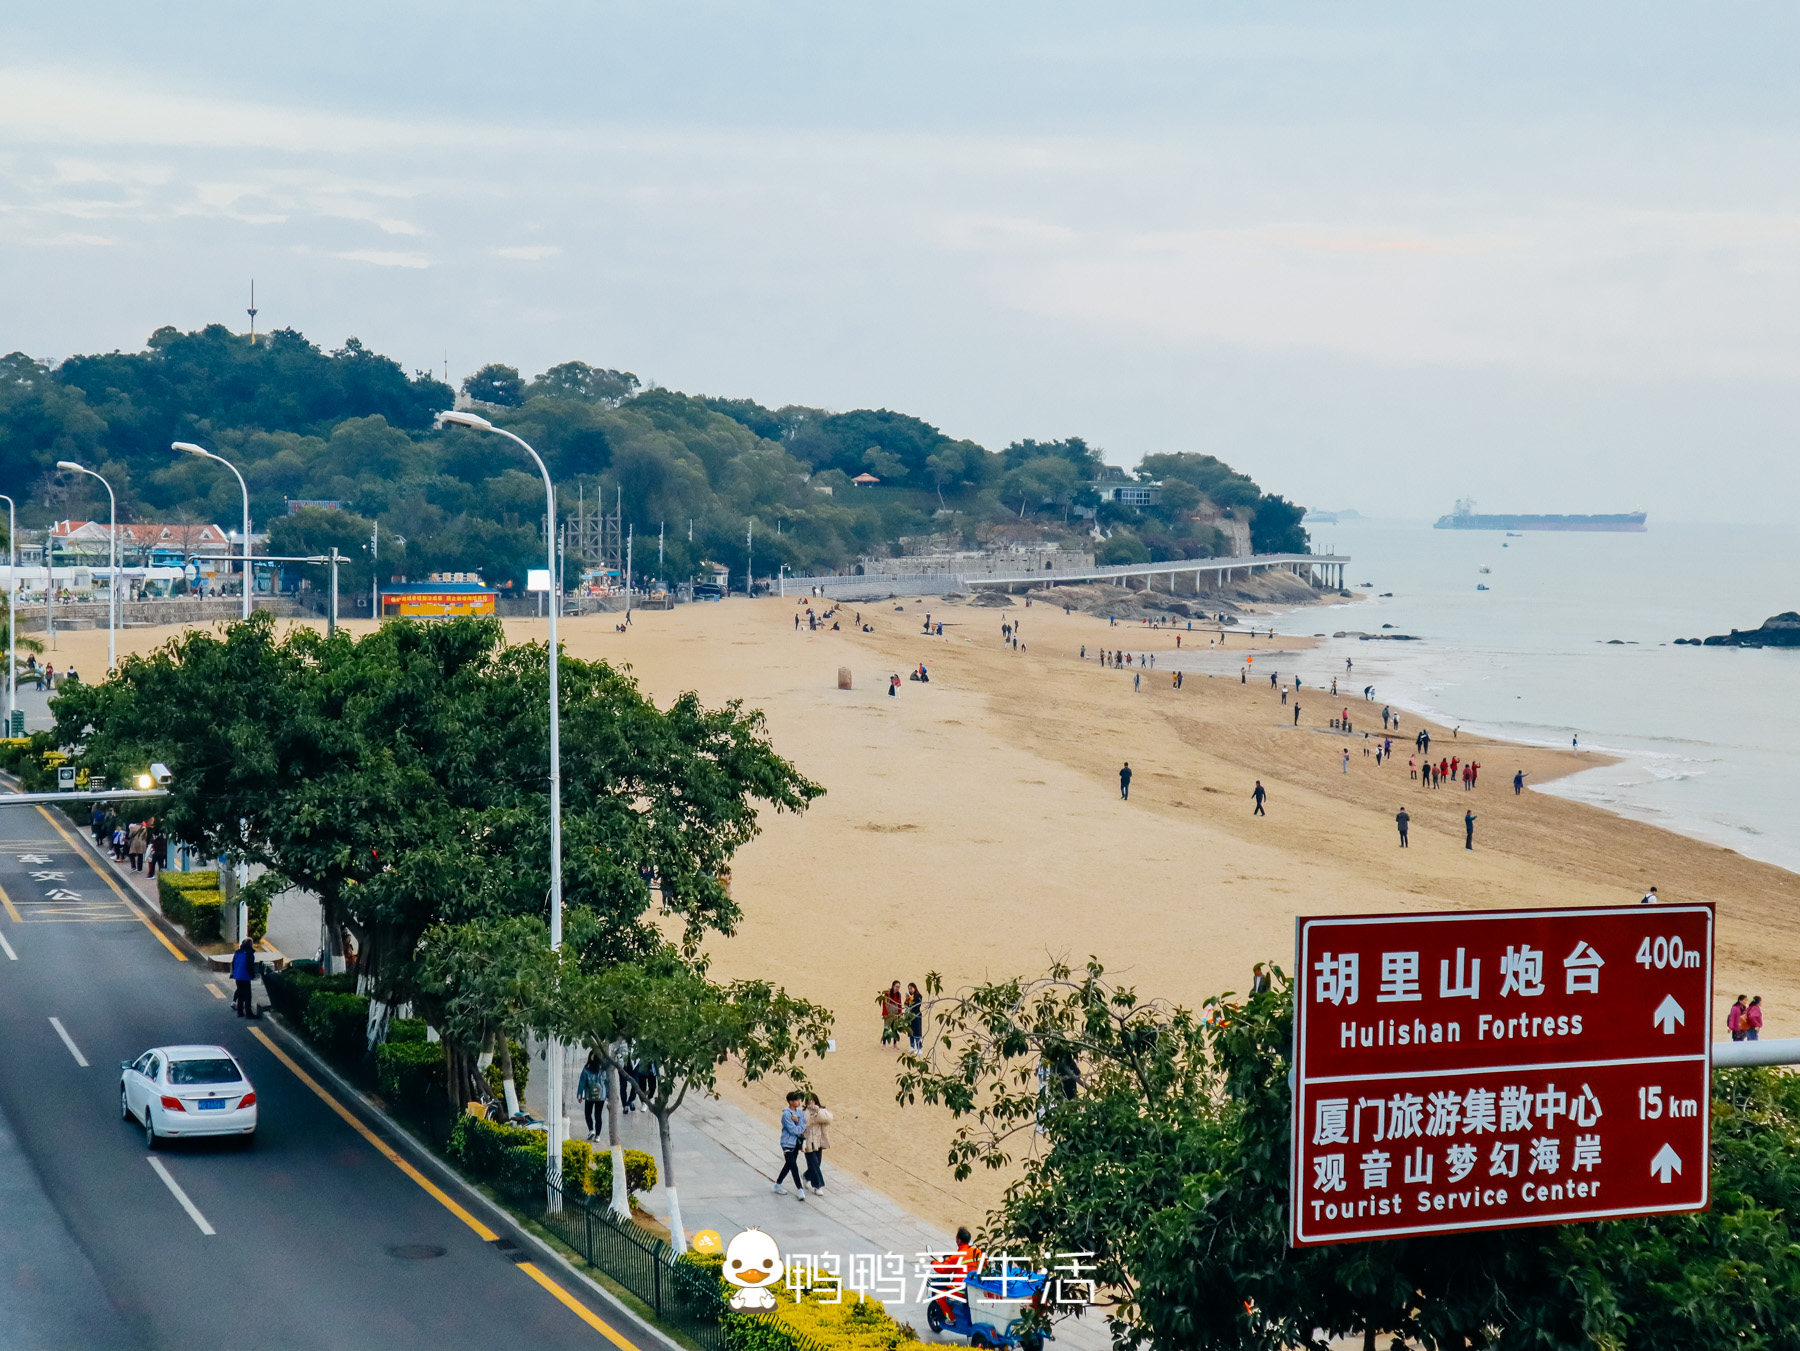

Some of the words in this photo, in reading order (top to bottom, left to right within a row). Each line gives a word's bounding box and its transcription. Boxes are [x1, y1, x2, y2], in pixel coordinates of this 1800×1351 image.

[1314, 941, 1605, 1006] 胡里山炮台
[1636, 936, 1700, 969] 400m
[1341, 1019, 1461, 1048] Hulishan
[1479, 1012, 1583, 1040] Fortress
[1312, 1083, 1603, 1146] 厦门旅游集散中心
[1639, 1086, 1663, 1121] 15
[1670, 1096, 1698, 1118] km
[1313, 1134, 1602, 1193] 观音山梦幻海岸
[1311, 1194, 1402, 1221] Tourist
[1418, 1186, 1508, 1212] Service
[1522, 1179, 1601, 1203] Center
